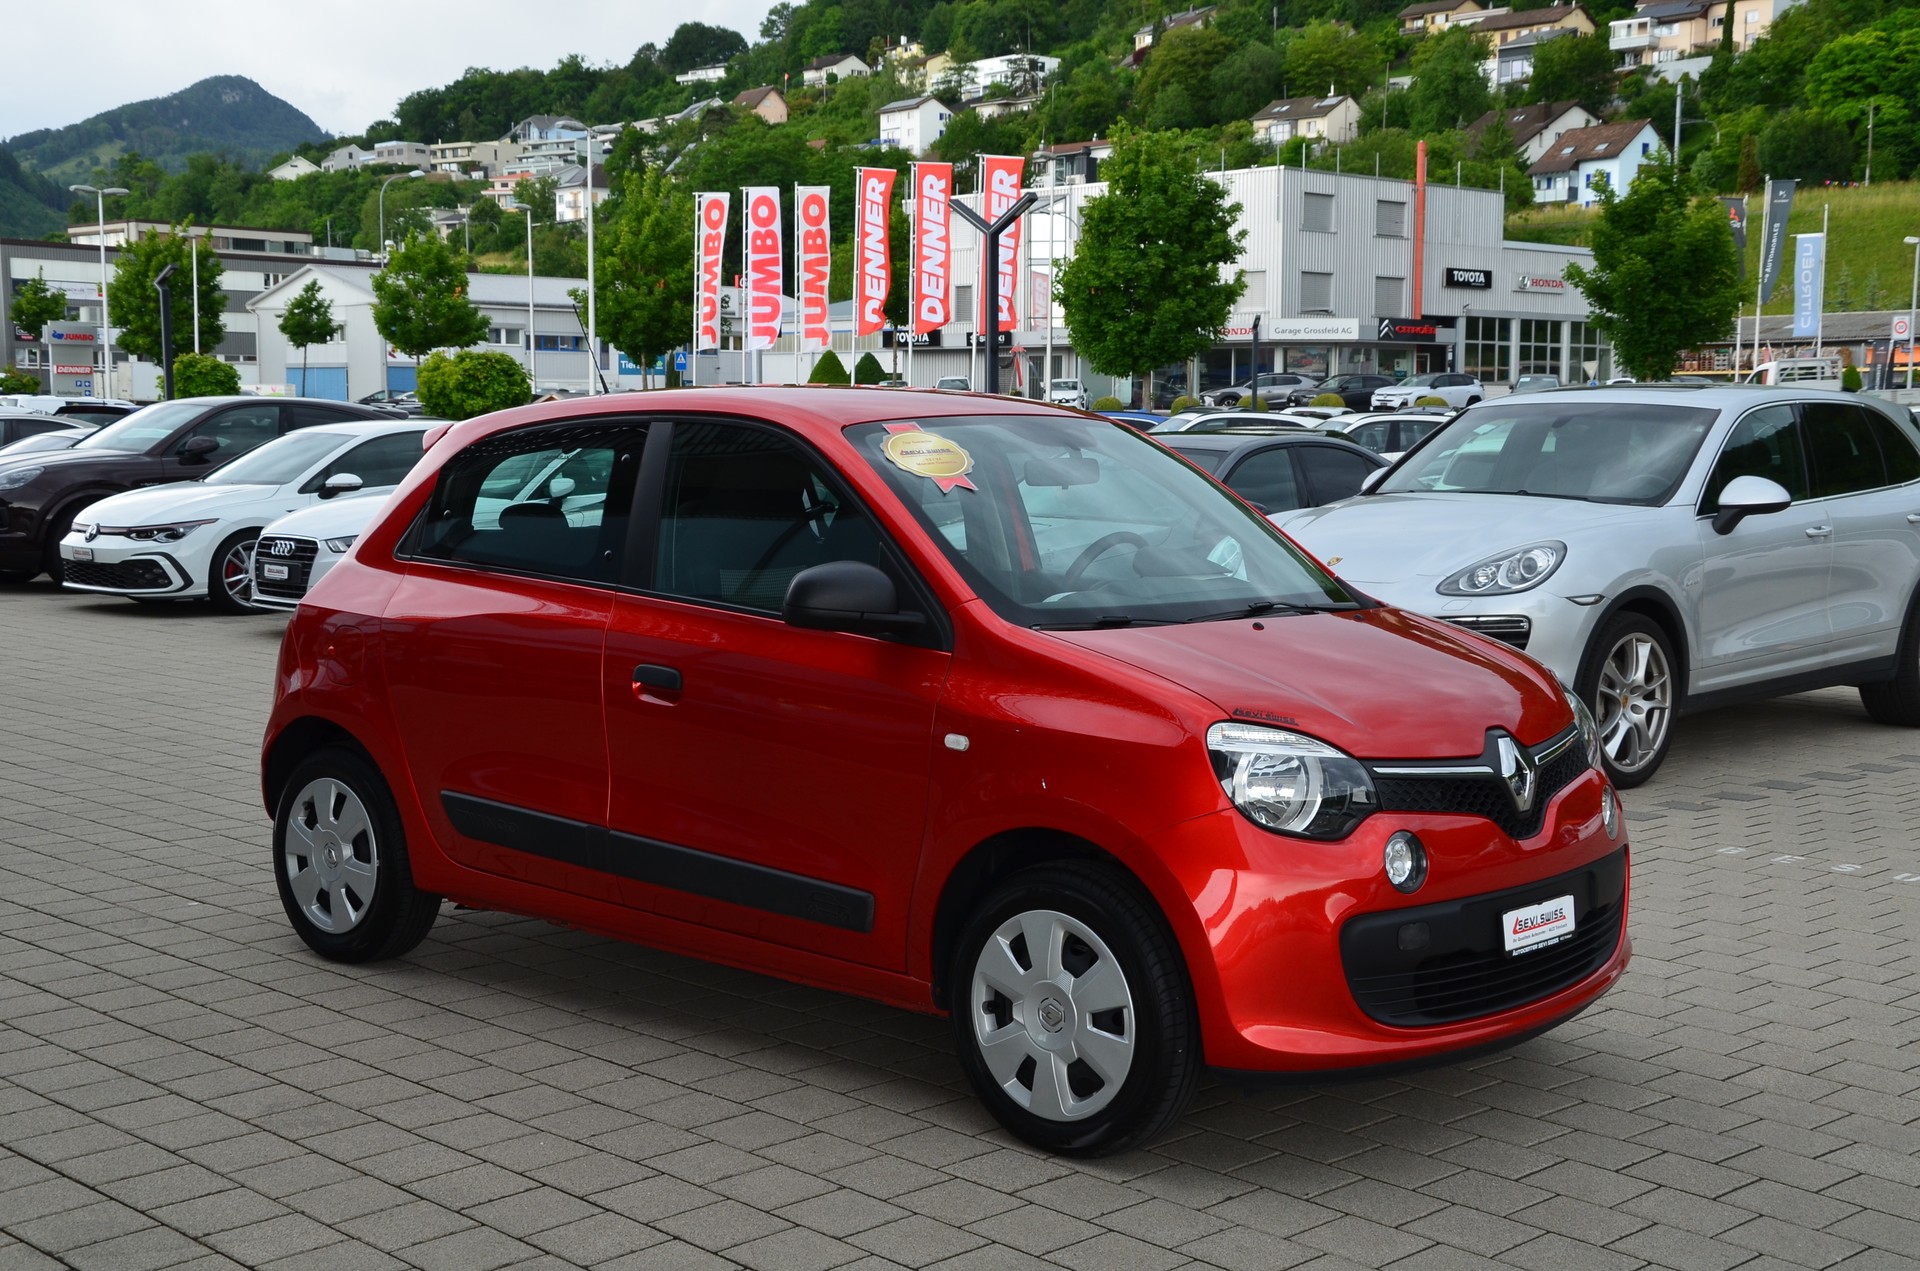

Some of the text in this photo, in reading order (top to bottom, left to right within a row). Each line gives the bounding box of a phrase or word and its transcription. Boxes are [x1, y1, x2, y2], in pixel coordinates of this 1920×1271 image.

[701, 198, 725, 345] JUMBO
[751, 194, 781, 345] JUMBO
[802, 193, 829, 346] JUMBO
[864, 177, 887, 324] DENNER
[920, 173, 946, 324] DENNER
[1452, 270, 1485, 283] TOYOTA
[1531, 278, 1564, 289] HONDA
[57, 366, 91, 374] DENNER
[64, 333, 94, 341] JUMBO
[1274, 326, 1353, 336] Garage Grossfeld AG
